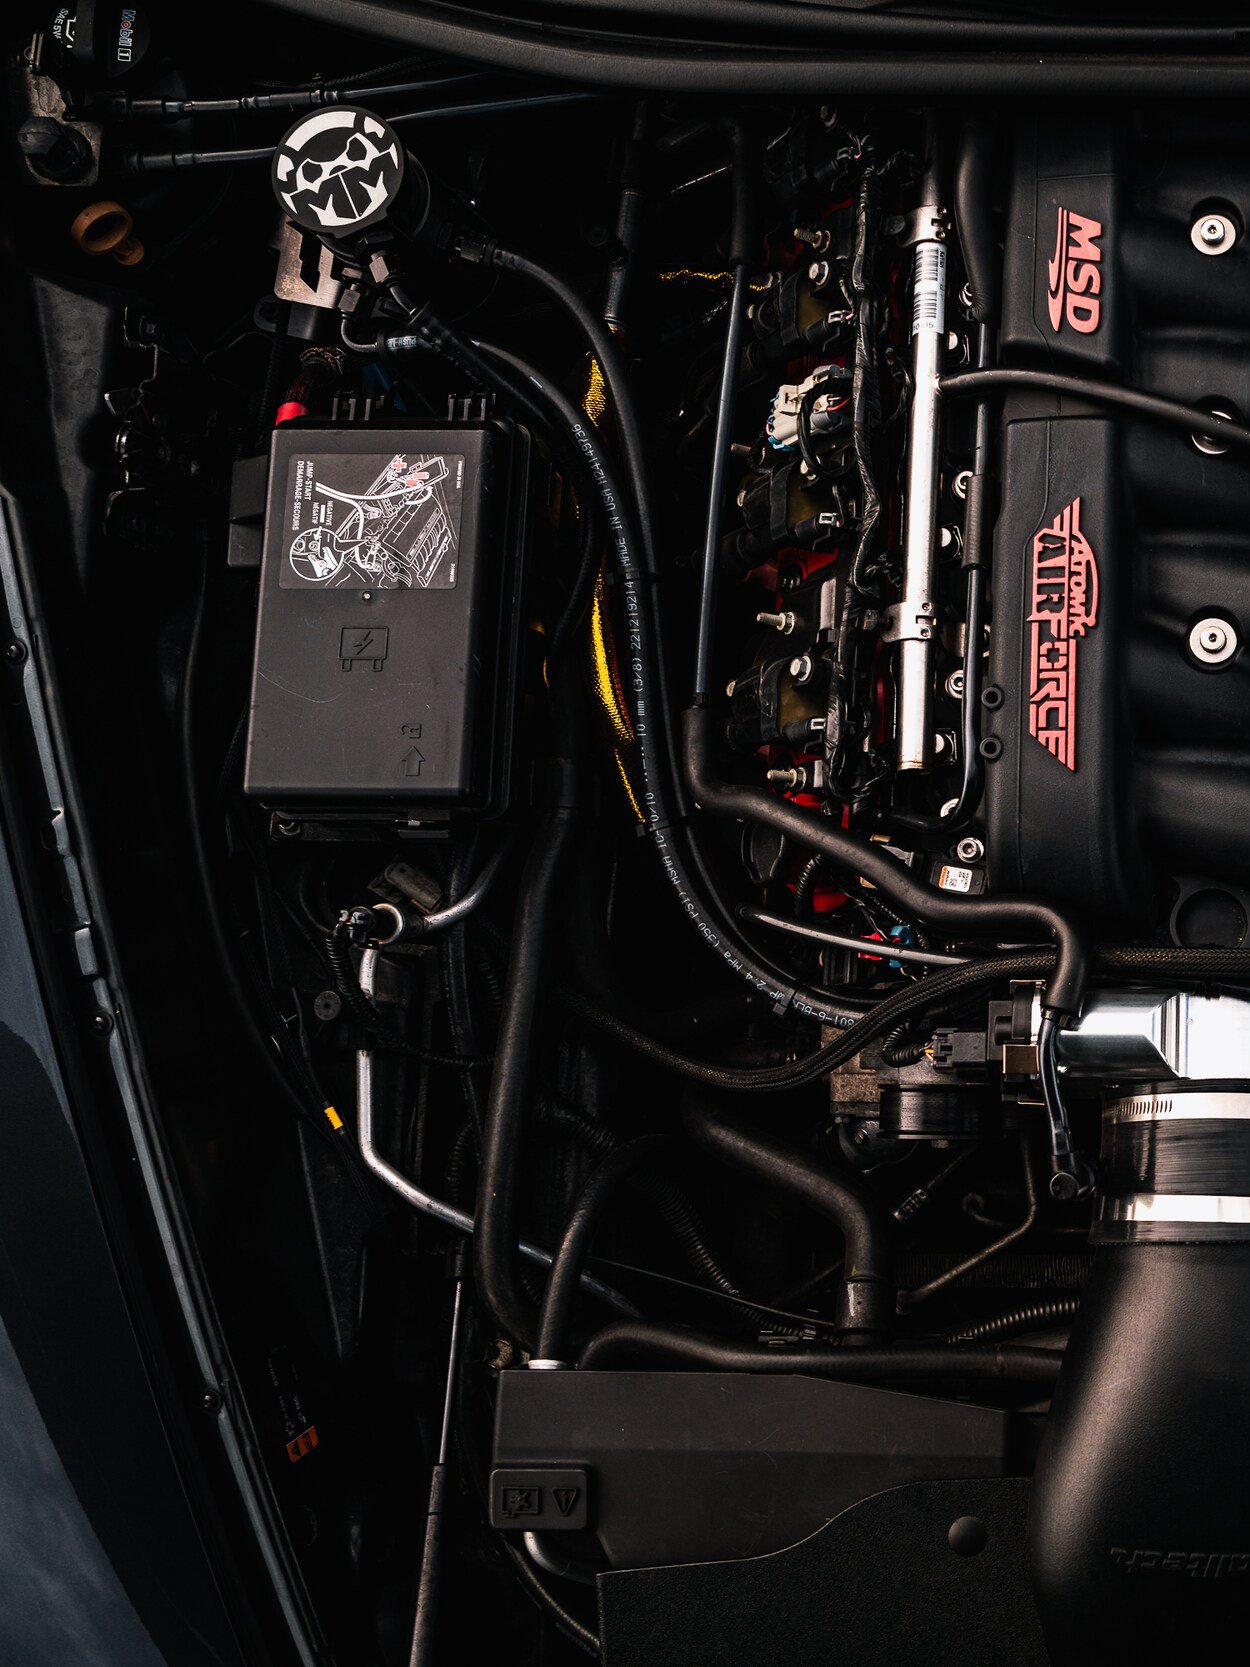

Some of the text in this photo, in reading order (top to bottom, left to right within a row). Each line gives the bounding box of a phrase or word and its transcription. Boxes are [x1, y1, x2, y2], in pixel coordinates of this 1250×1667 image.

[54, 8, 69, 25] SAE
[119, 9, 136, 47] Mobil
[1066, 211, 1102, 333] MSD
[571, 423, 607, 486] H24149736
[305, 460, 315, 501] JUMP-START
[325, 500, 334, 526] NEGATIVE
[600, 488, 616, 512] USA
[608, 516, 623, 531] IN
[614, 536, 631, 567] MADE
[632, 657, 644, 693] (3/8)
[637, 700, 647, 716] mm
[636, 723, 647, 737] 10
[645, 792, 667, 848] IC-0/10
[661, 854, 681, 887] MSHA
[677, 890, 700, 920] PSI)
[697, 921, 722, 950] (350
[722, 950, 746, 973] MPa
[745, 970, 768, 991] 2.4
